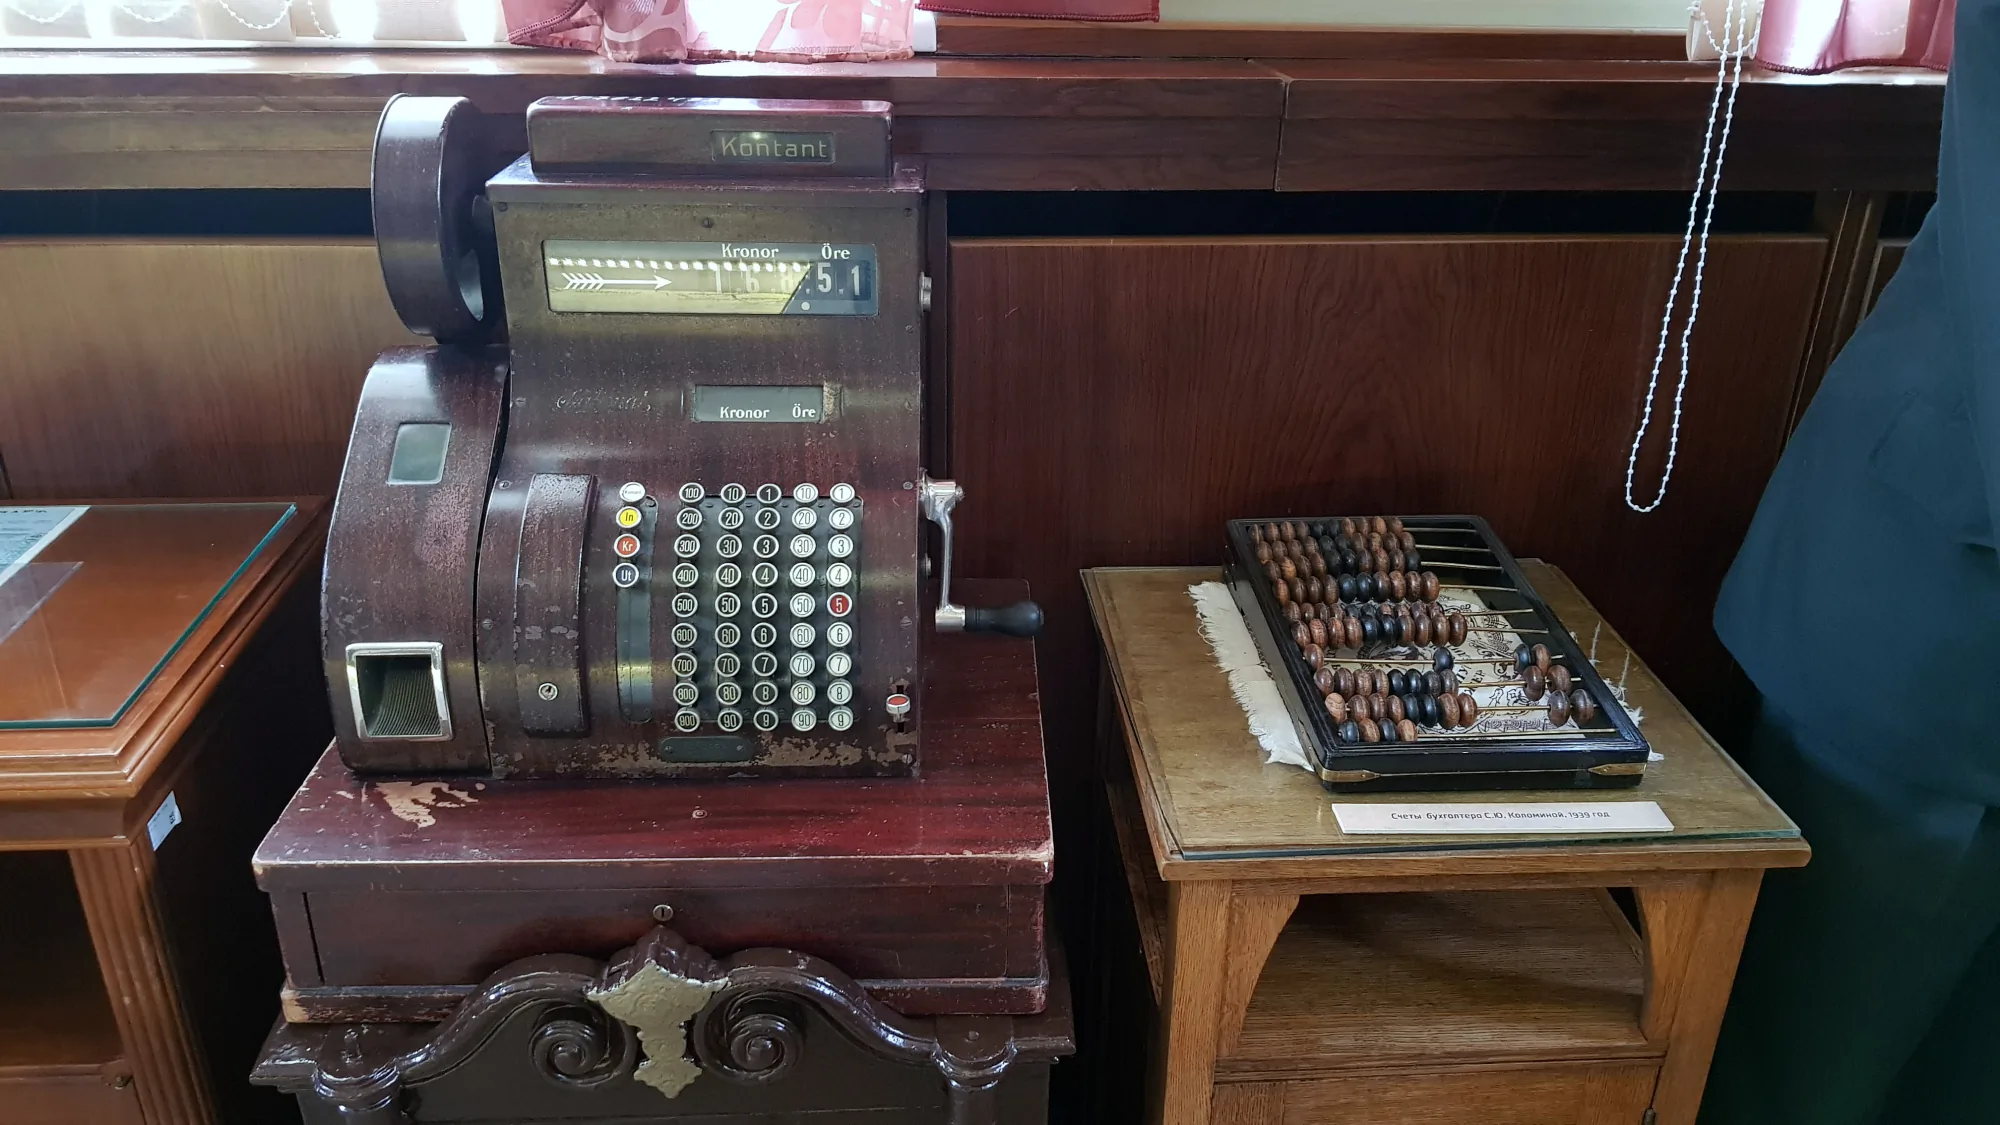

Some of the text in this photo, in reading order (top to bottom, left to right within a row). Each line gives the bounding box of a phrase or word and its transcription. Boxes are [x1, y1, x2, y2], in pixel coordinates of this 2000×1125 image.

[722, 136, 828, 158] Kontant
[721, 243, 851, 260] Kronor Öre
[720, 403, 816, 419] Kronor Öre
[685, 487, 699, 499] 100
[727, 488, 739, 500] 10
[765, 488, 771, 500] 1
[801, 487, 812, 500] 10
[839, 487, 844, 499] 1
[625, 512, 634, 522] In
[681, 513, 699, 524] 200
[725, 512, 739, 525] 20
[764, 513, 771, 525] 2
[798, 512, 811, 525] 20
[839, 513, 845, 525] 2
[622, 541, 633, 552] Kr
[679, 539, 696, 552] 300
[723, 539, 736, 554] 30
[763, 539, 770, 554] 3
[797, 539, 810, 554] 30
[838, 539, 845, 553] 3
[621, 569, 632, 582] Ut
[677, 569, 694, 582] 400
[720, 568, 735, 583] 40
[760, 568, 769, 582] 4
[795, 568, 808, 582] 40
[834, 568, 842, 582] 4
[677, 598, 693, 612] 500
[721, 597, 735, 612] 50
[761, 598, 769, 614] 5
[797, 597, 809, 613] 50
[835, 597, 843, 613] 5
[721, 628, 735, 644] 60
[760, 628, 767, 643] 6
[797, 628, 809, 643] 60
[836, 628, 843, 643] 6
[677, 659, 692, 672] 700
[721, 658, 735, 673] 70
[761, 658, 769, 672] 7
[797, 657, 809, 673] 70
[836, 657, 843, 672] 7
[678, 688, 694, 700] 800
[722, 686, 736, 701] 80
[762, 686, 769, 700] 8
[797, 686, 809, 700] 80
[836, 686, 843, 700] 8
[724, 714, 737, 728] 90
[763, 714, 770, 727] 9
[798, 714, 811, 728] 90
[837, 714, 844, 727] 9
[1391, 812, 1422, 820] Счеты
[1426, 812, 1483, 820] бухгалтера
[1484, 811, 1507, 819] С.Ю.
[1568, 811, 1591, 819] 1939
